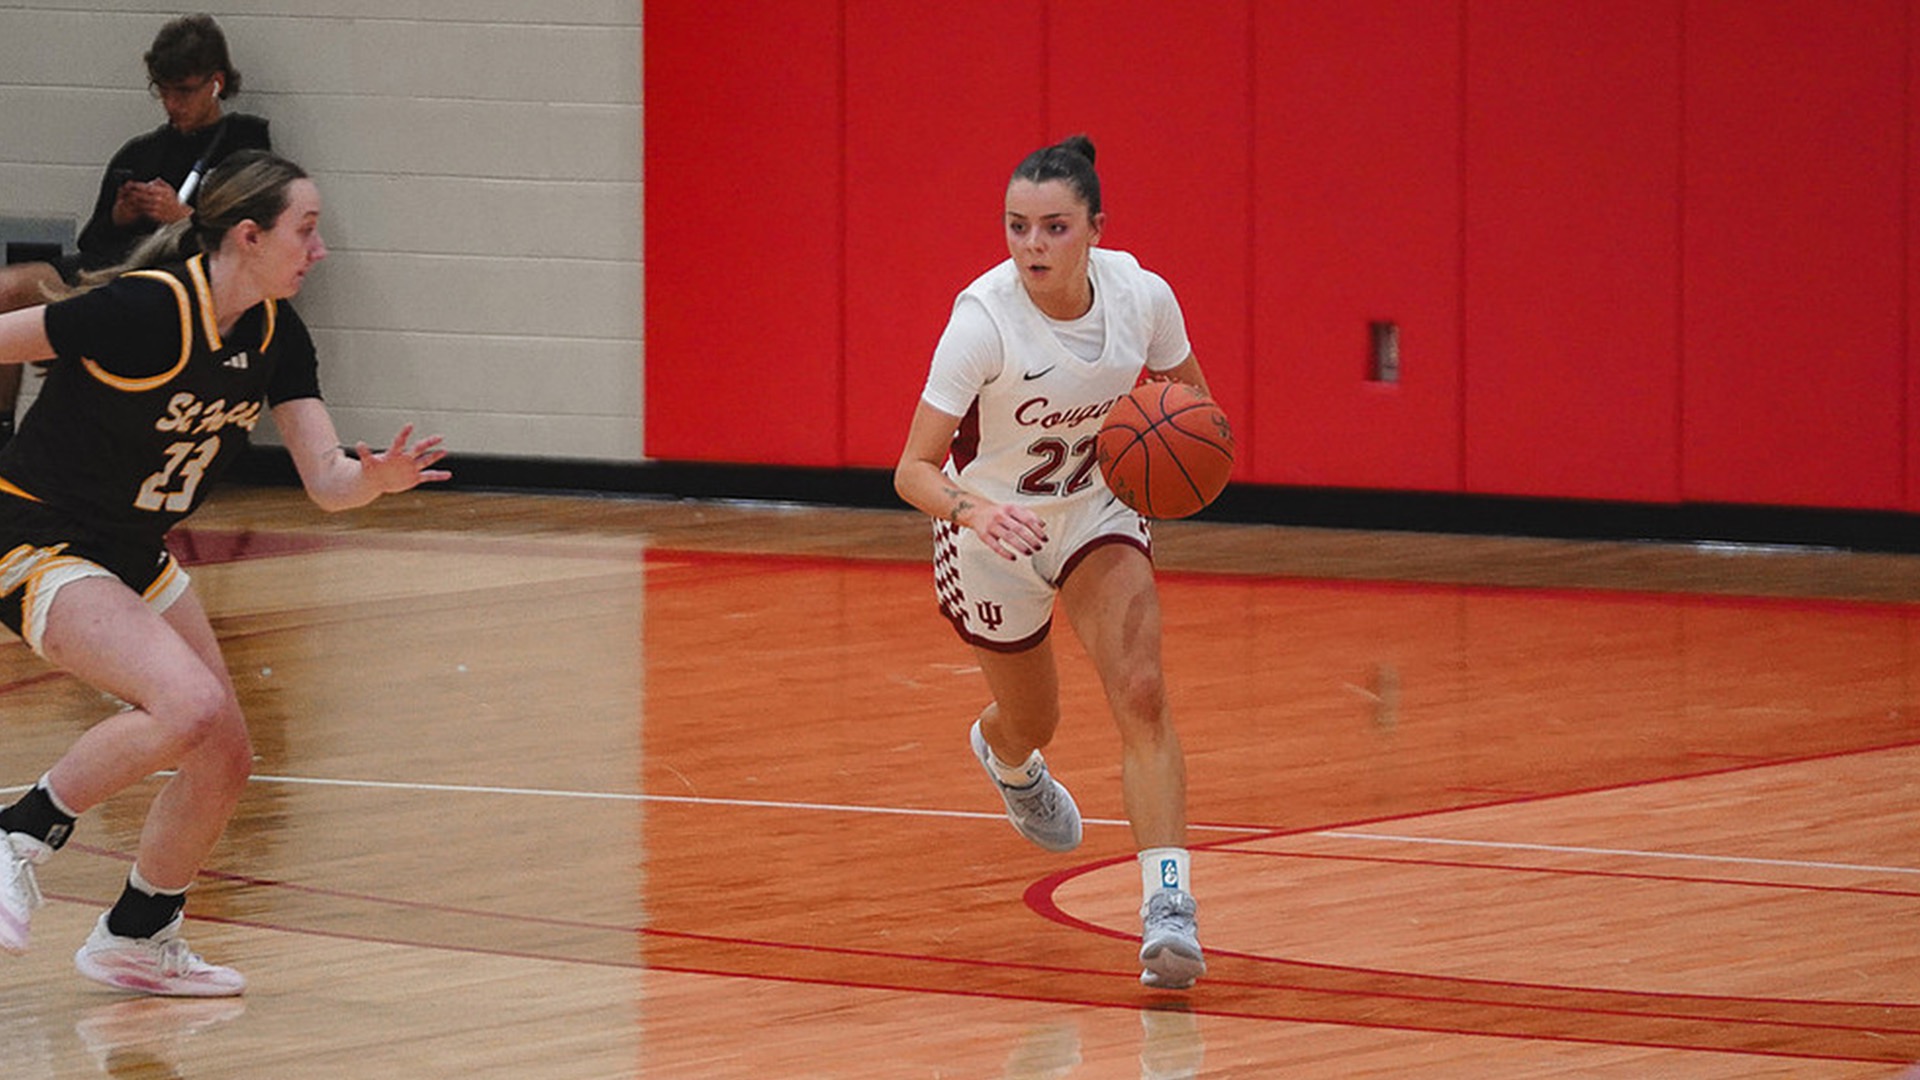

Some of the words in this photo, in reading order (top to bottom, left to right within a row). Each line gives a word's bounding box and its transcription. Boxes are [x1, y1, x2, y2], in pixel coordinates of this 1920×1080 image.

[1015, 397, 1122, 429] Couga
[133, 434, 221, 512] 23
[1016, 435, 1099, 497] 22
